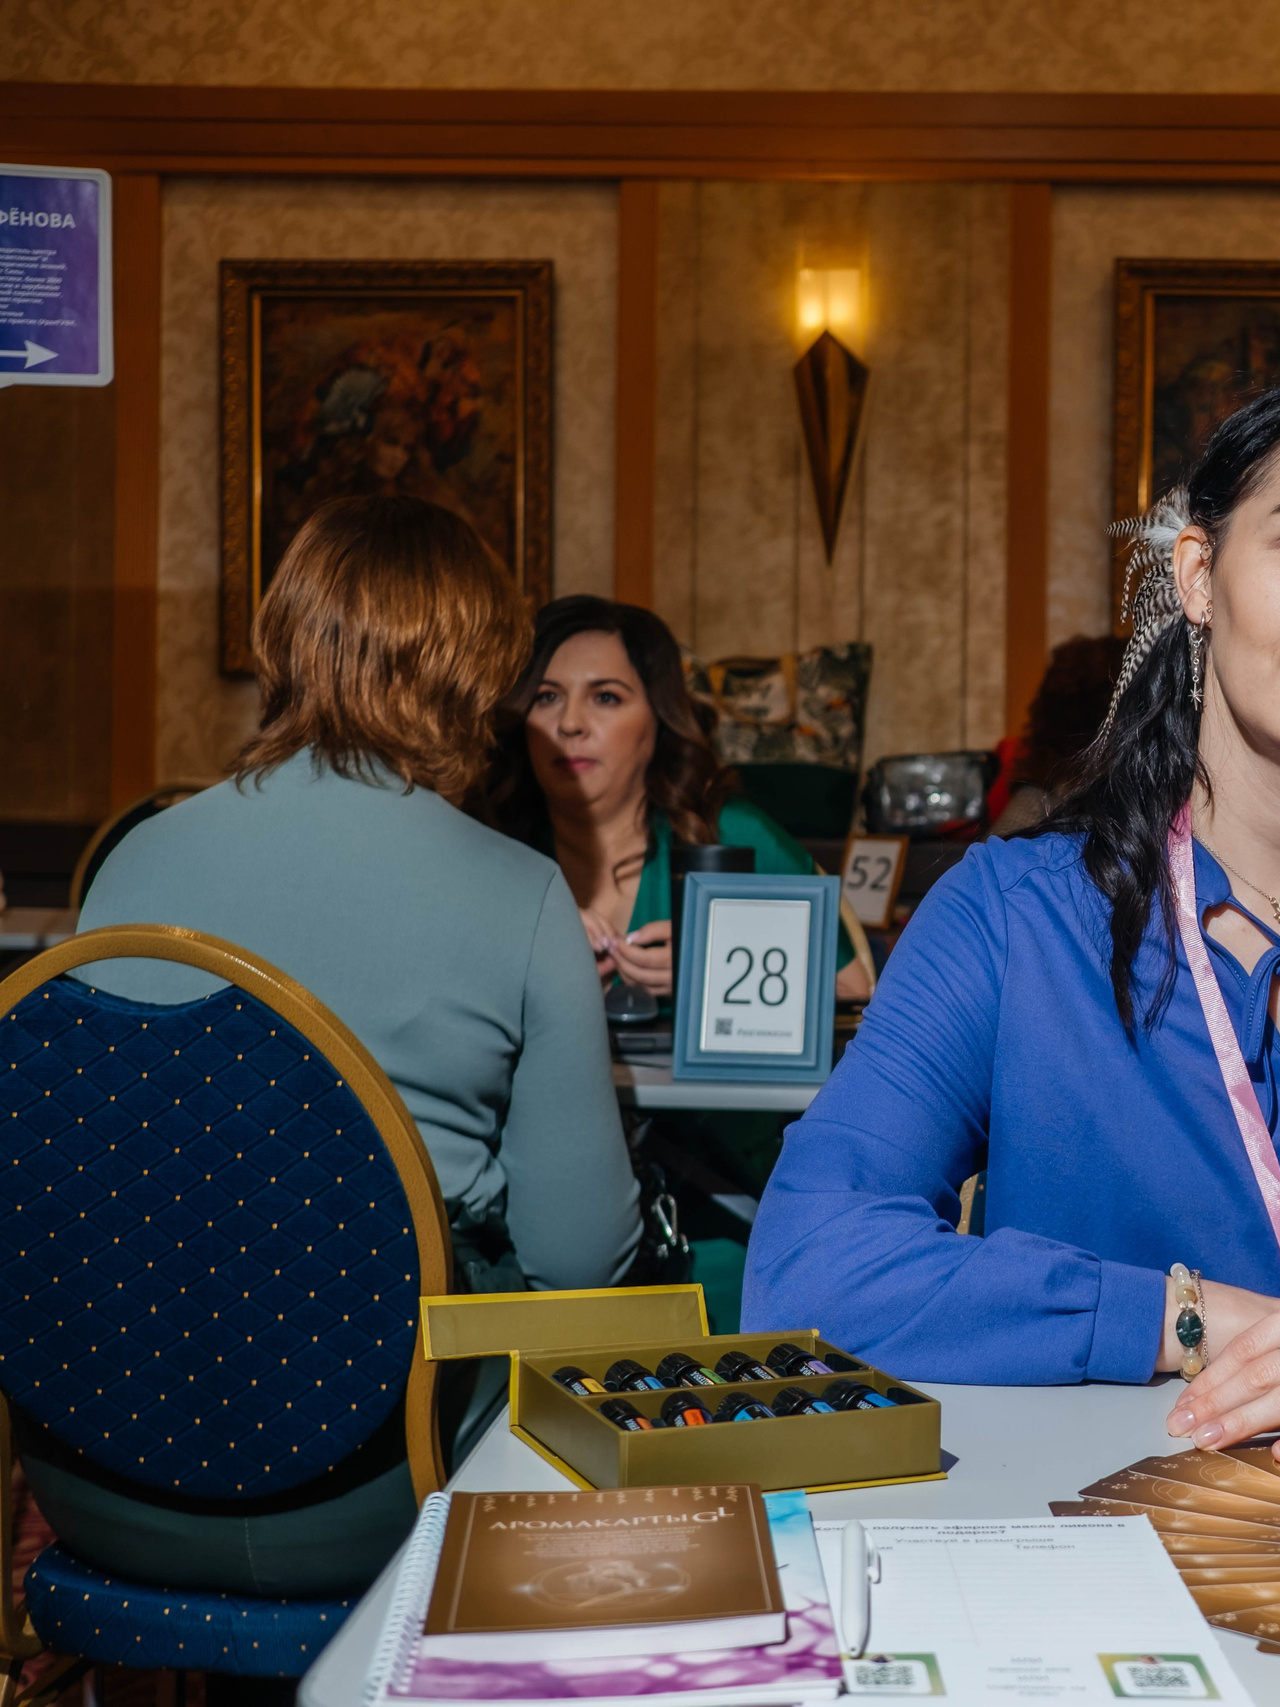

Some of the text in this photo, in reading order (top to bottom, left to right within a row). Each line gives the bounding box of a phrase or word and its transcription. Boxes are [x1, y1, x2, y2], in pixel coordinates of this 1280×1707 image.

[846, 855, 893, 892] 52
[723, 946, 789, 1006] 28
[489, 1513, 687, 1530] АРОМАКАРТЫ
